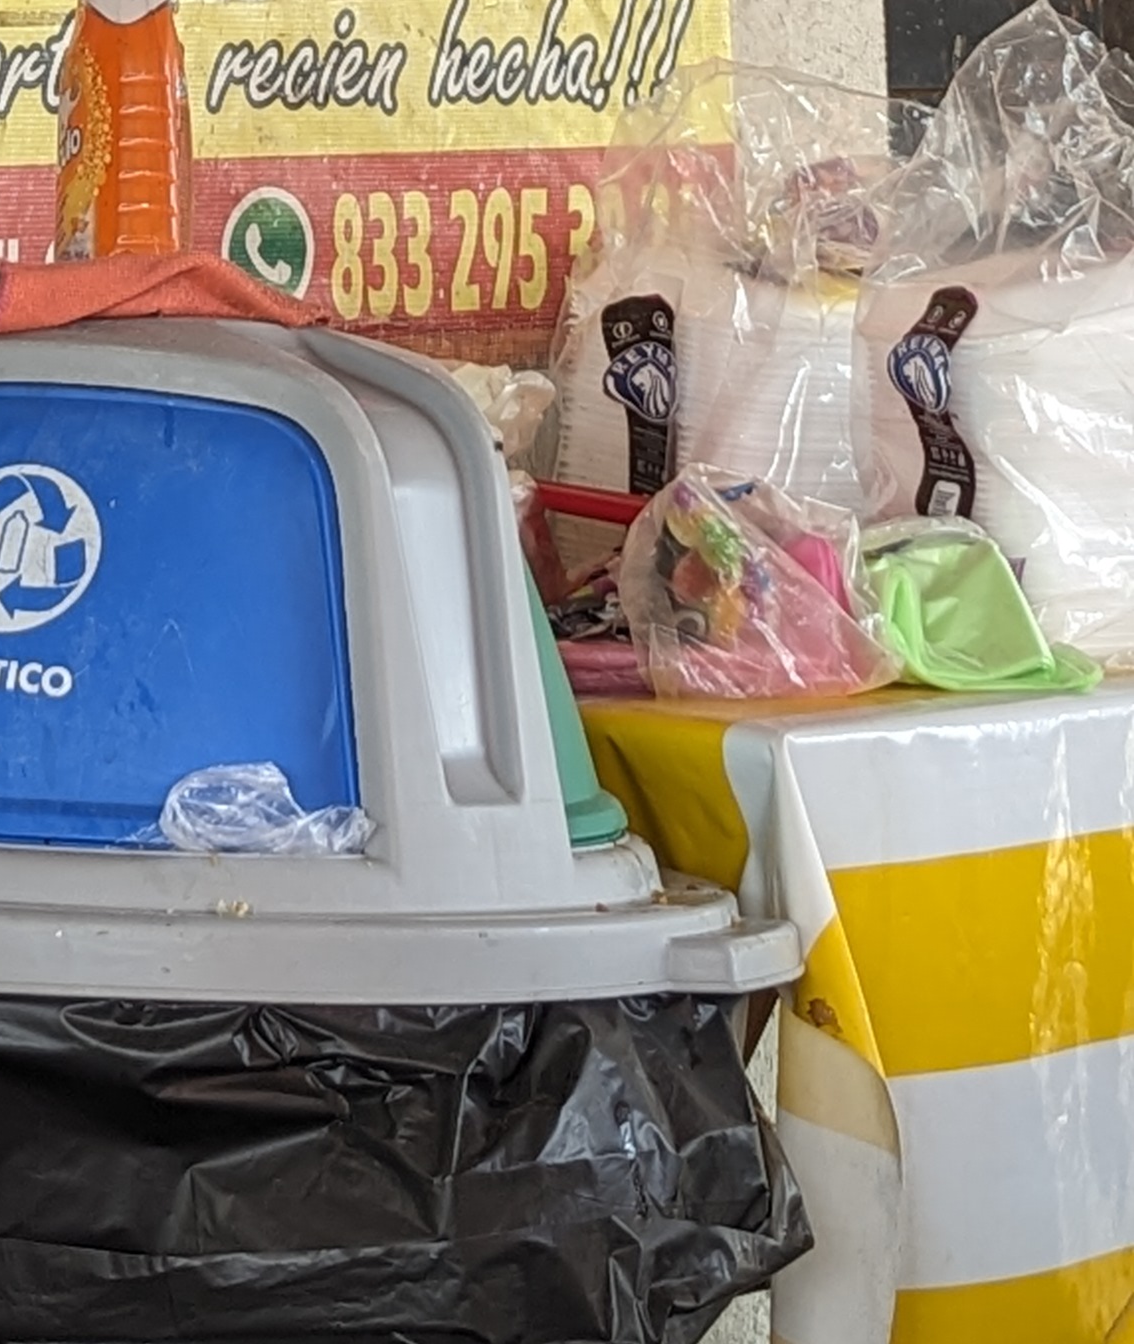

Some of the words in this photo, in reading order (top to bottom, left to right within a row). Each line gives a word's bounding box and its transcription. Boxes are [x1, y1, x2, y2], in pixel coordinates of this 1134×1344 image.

[207, 10, 406, 115] recien
[330, 190, 434, 321] 833
[450, 188, 549, 313] 295
